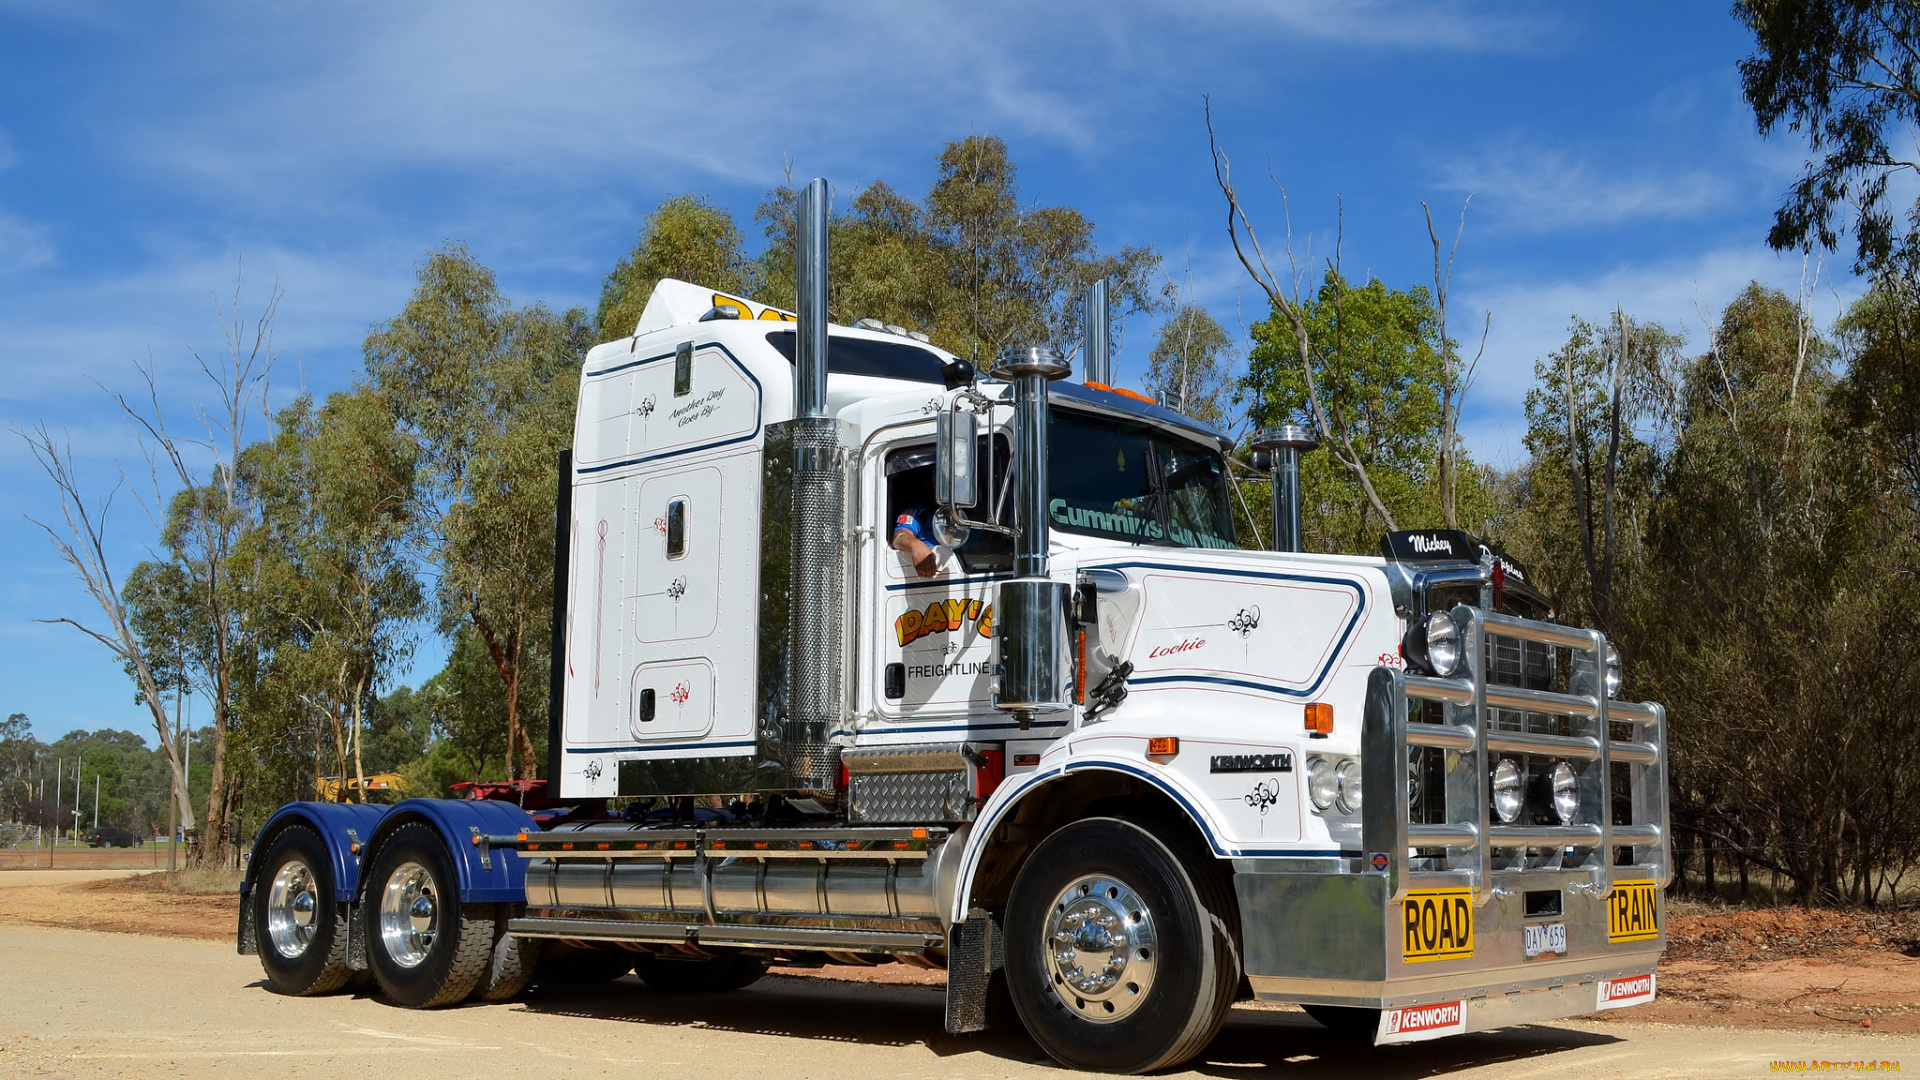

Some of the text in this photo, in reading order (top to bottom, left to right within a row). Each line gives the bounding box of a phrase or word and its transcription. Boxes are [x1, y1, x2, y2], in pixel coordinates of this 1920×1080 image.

[668, 387, 726, 421] Another Day
[678, 412, 699, 428] Goes
[1049, 498, 1164, 539] Cummins
[1408, 533, 1453, 555] Mickey
[1148, 636, 1207, 659] Lochie
[1210, 754, 1292, 773] KENWORTH
[1607, 888, 1658, 933] TRAIN
[1405, 898, 1470, 952] ROAD
[1526, 926, 1565, 949] DAY 659
[1611, 977, 1650, 997] KENWORTH
[1402, 1005, 1459, 1029] KENWORTH
